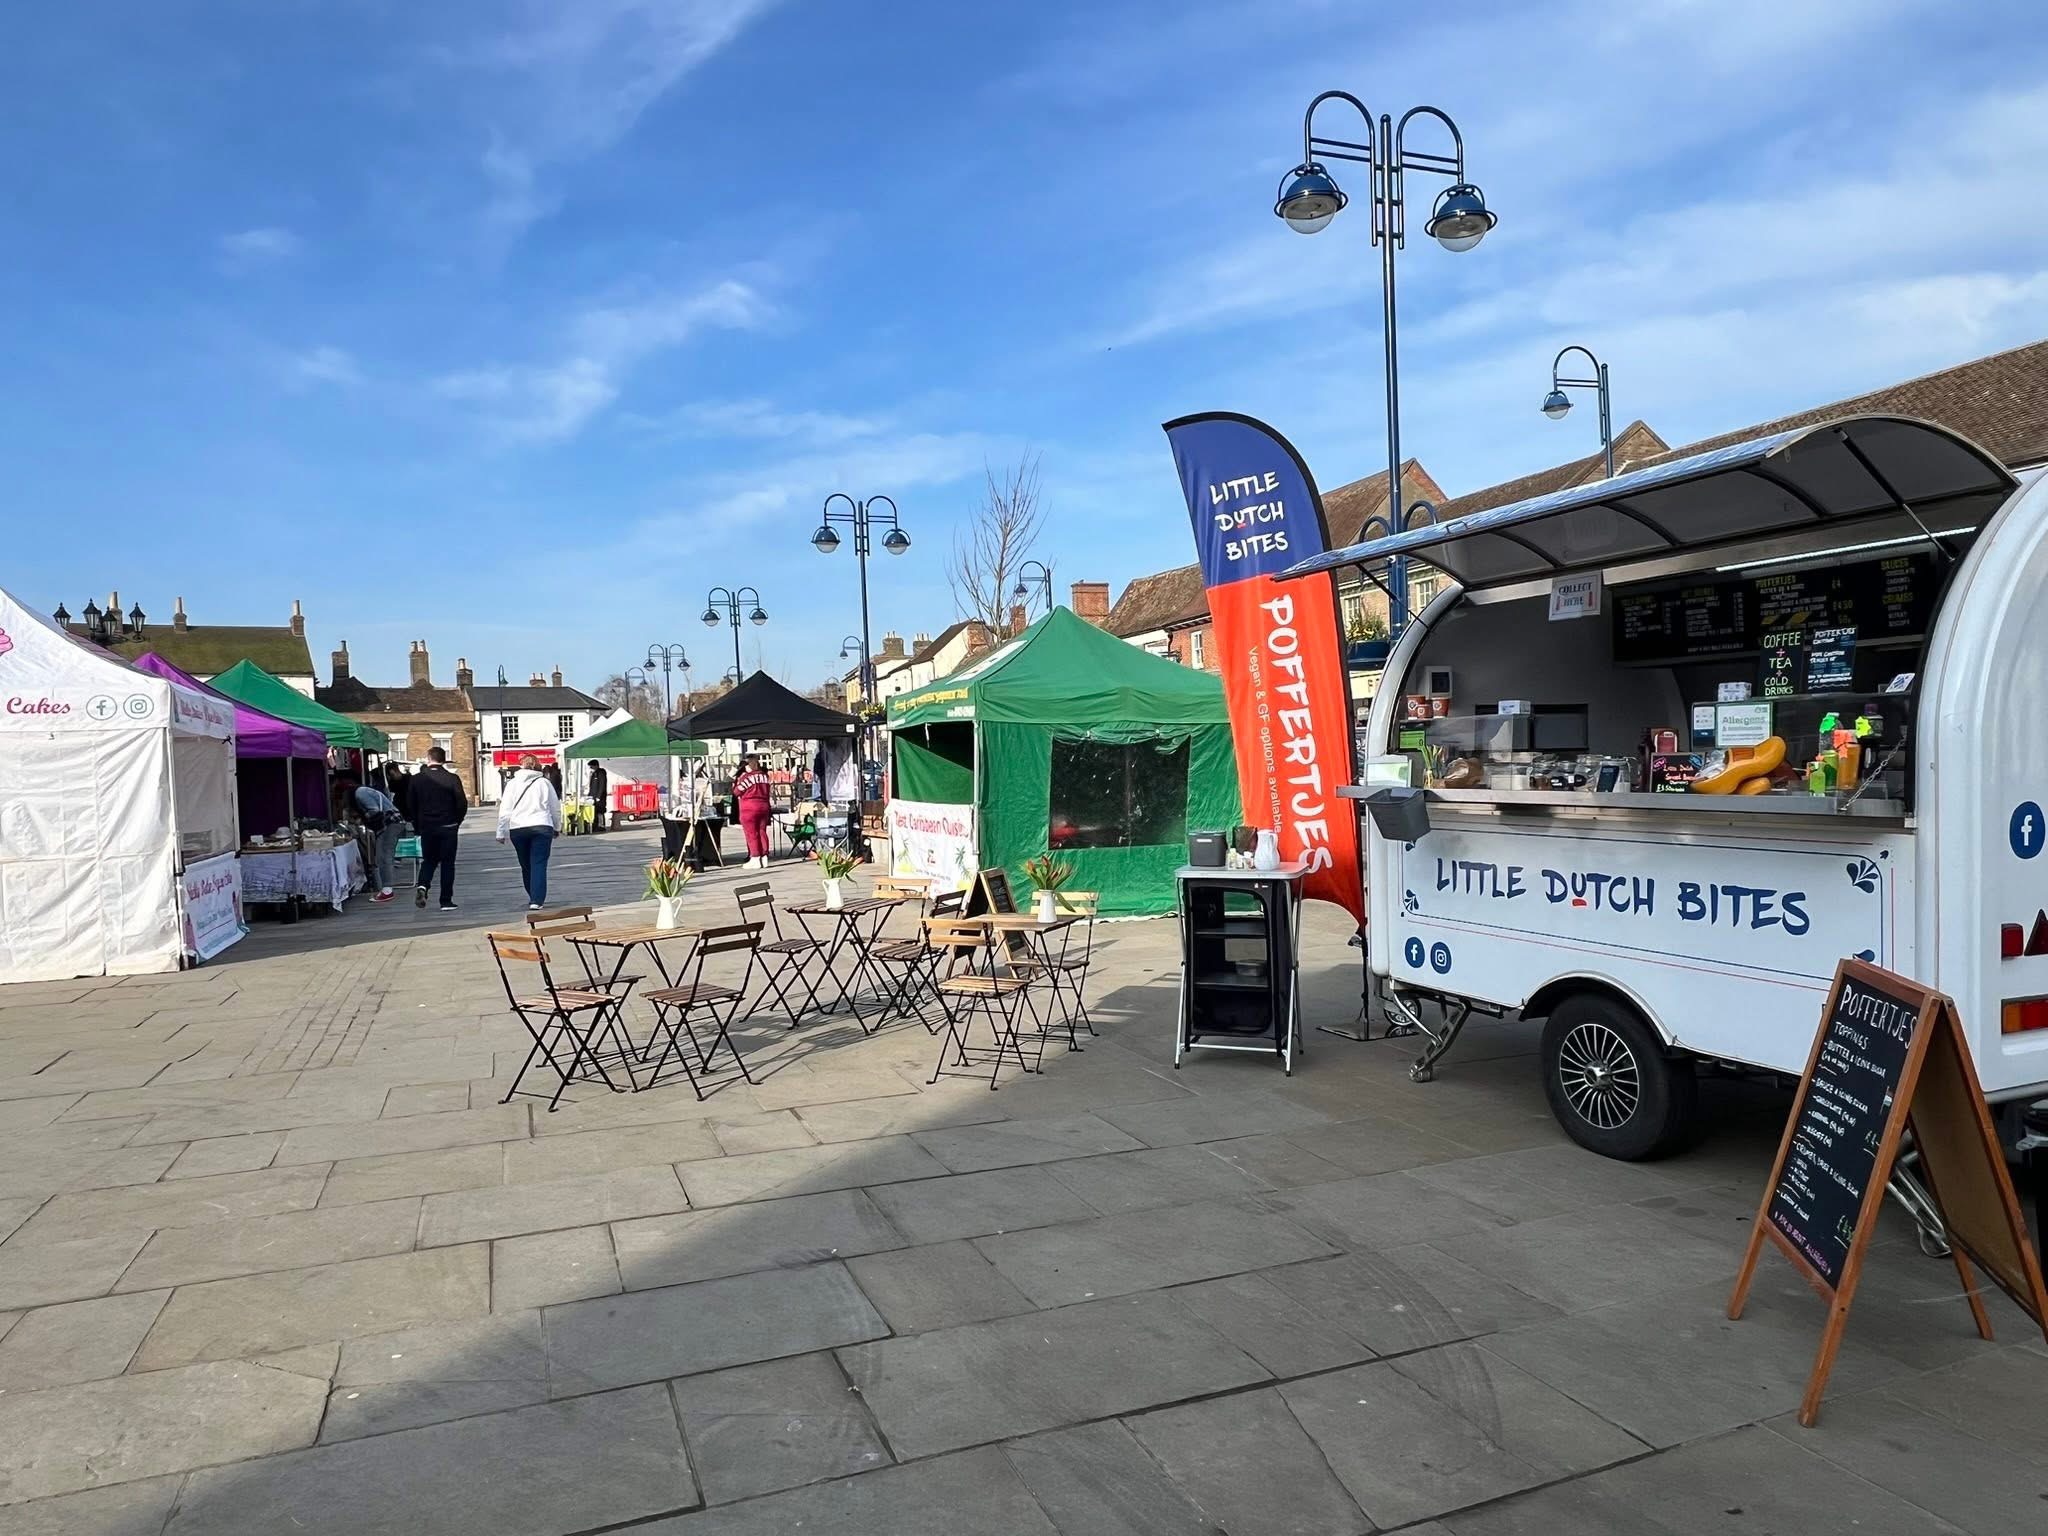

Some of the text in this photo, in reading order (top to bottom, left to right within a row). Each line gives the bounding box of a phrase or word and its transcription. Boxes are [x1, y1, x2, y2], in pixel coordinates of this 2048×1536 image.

[1209, 472, 1280, 505] LITTLE
[1214, 501, 1284, 532] DUTCH
[1226, 531, 1289, 561] BITES
[1558, 582, 1593, 596] COLLECT
[1763, 631, 1801, 649] COFFEE
[1769, 657, 1793, 669] TEA
[1764, 676, 1789, 687] COLD
[1764, 686, 1794, 696] DRINKS
[6, 697, 71, 714] Cakes
[1259, 593, 1334, 874] POFFERTJES
[1722, 715, 1767, 726] Allergens
[1248, 645, 1283, 834] Vegan & GF options available
[1437, 858, 1811, 936] LITTLE DUTCH BITES
[1840, 984, 1918, 1050] POFFERTJES
[1835, 1022, 1868, 1050] TOPPINGS
